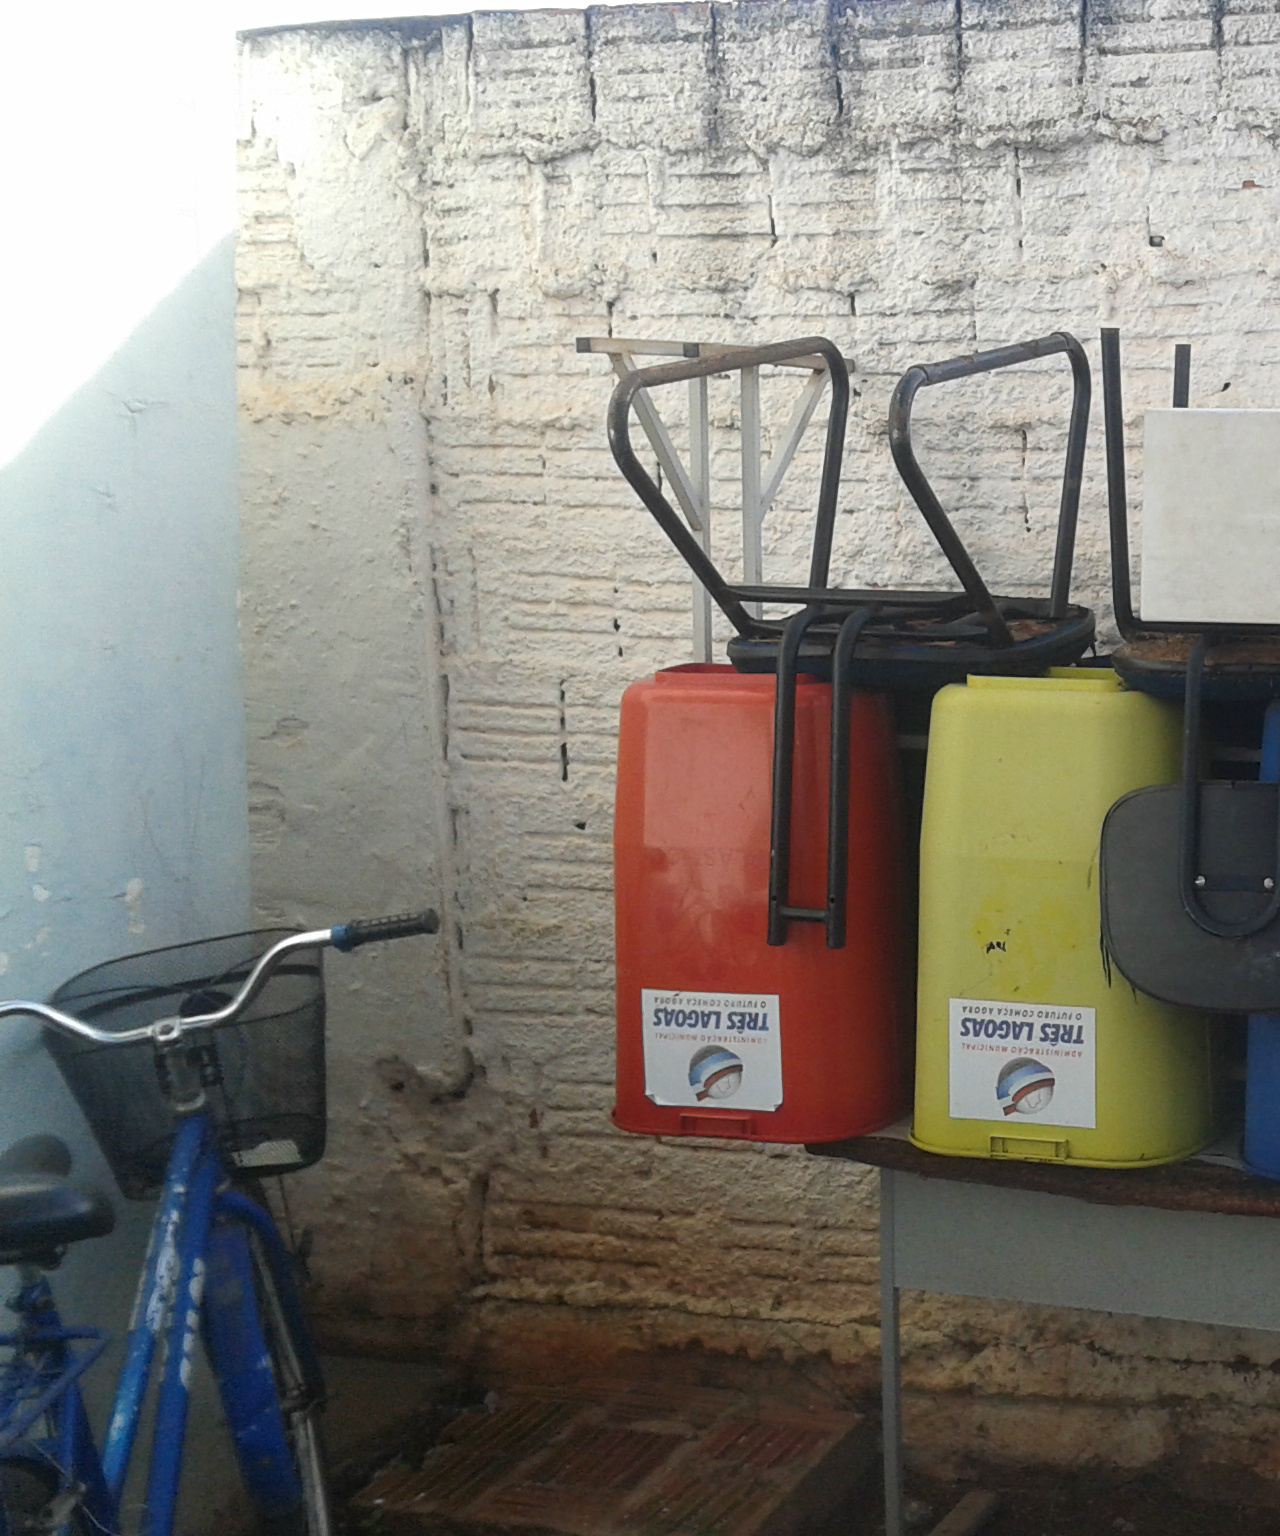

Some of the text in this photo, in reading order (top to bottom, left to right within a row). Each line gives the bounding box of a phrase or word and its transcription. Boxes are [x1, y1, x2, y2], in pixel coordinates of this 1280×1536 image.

[724, 1000, 758, 1008] FUTURO
[962, 1006, 994, 1015] AGORA
[997, 1007, 1034, 1017] COMEÇA
[1037, 1011, 1072, 1020] FUTURO
[653, 1008, 769, 1034] TRÊS LAGOAS
[960, 1017, 1084, 1046] TRÊS LAGOAS
[961, 1043, 1083, 1058] ADMINISTRAÇÃO MUNICIPAL
